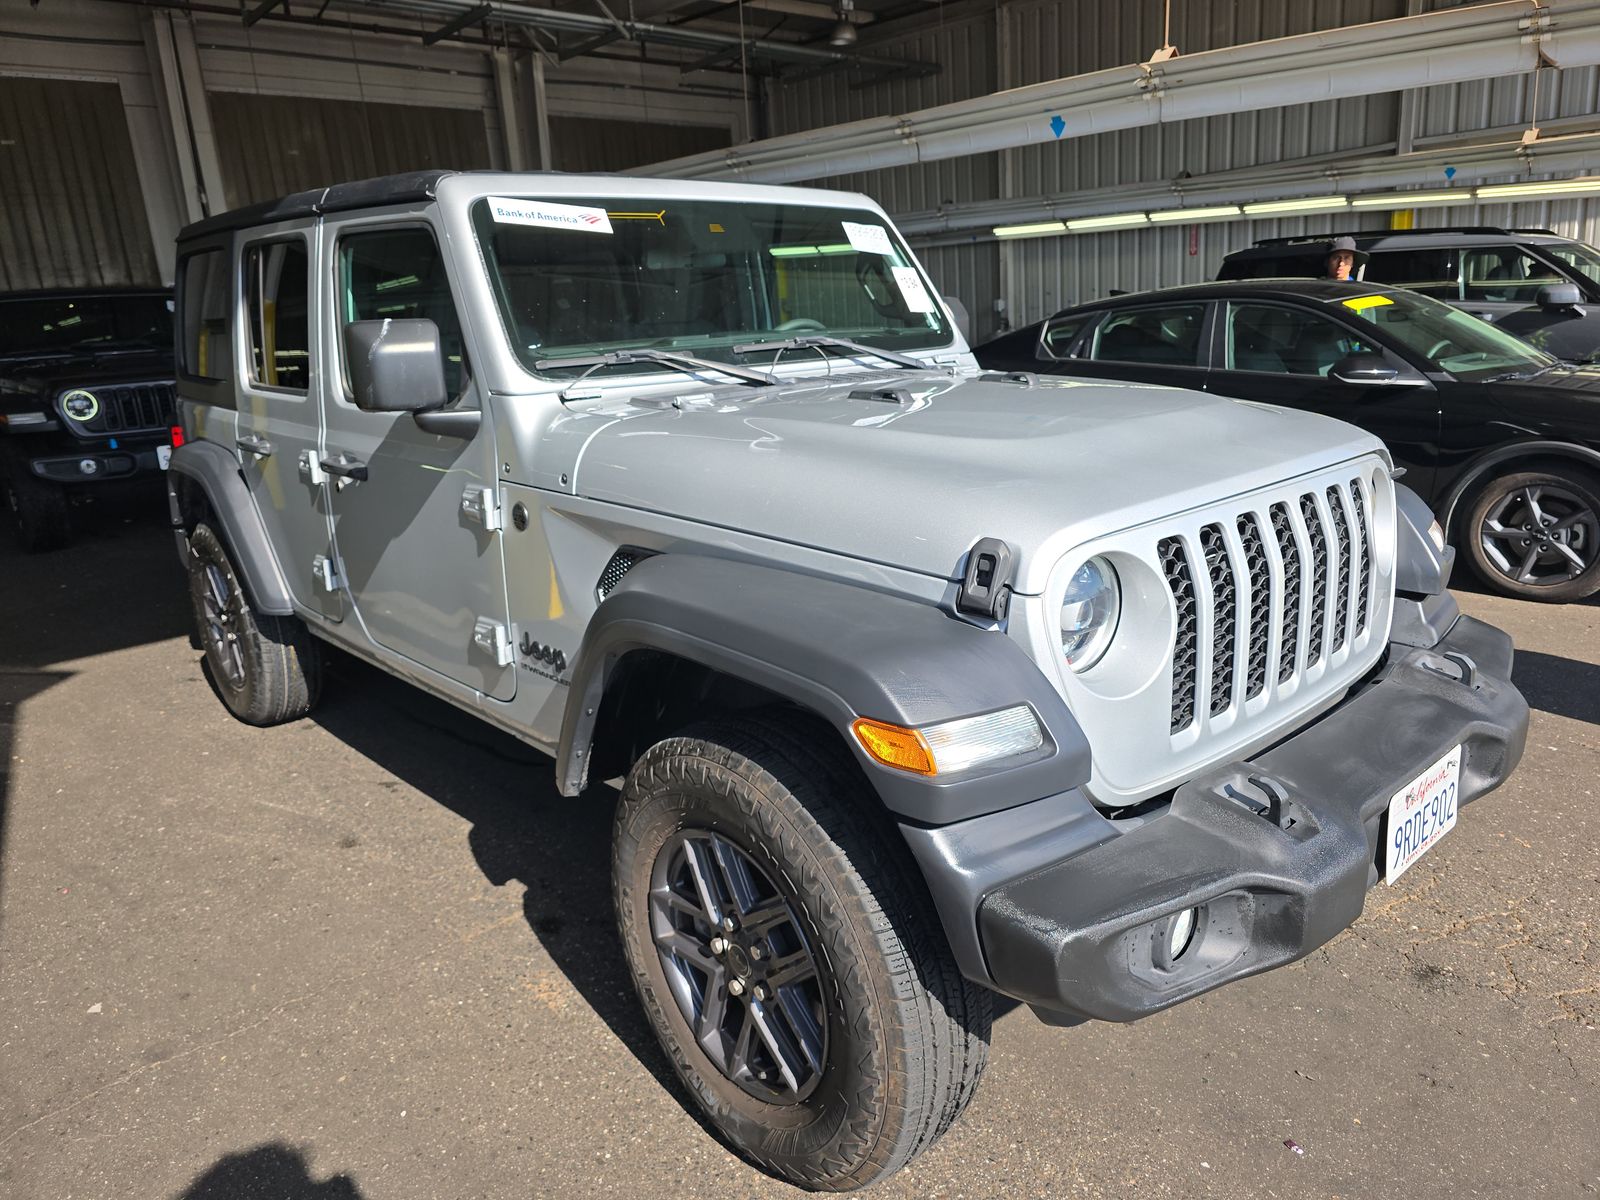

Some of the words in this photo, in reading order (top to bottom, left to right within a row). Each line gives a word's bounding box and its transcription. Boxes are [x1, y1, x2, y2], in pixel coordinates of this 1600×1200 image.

[497, 207, 524, 218] Bank
[525, 211, 536, 219] of
[537, 212, 578, 224] America
[519, 631, 566, 674] Jeep
[1394, 781, 1455, 869] 9RDE902
